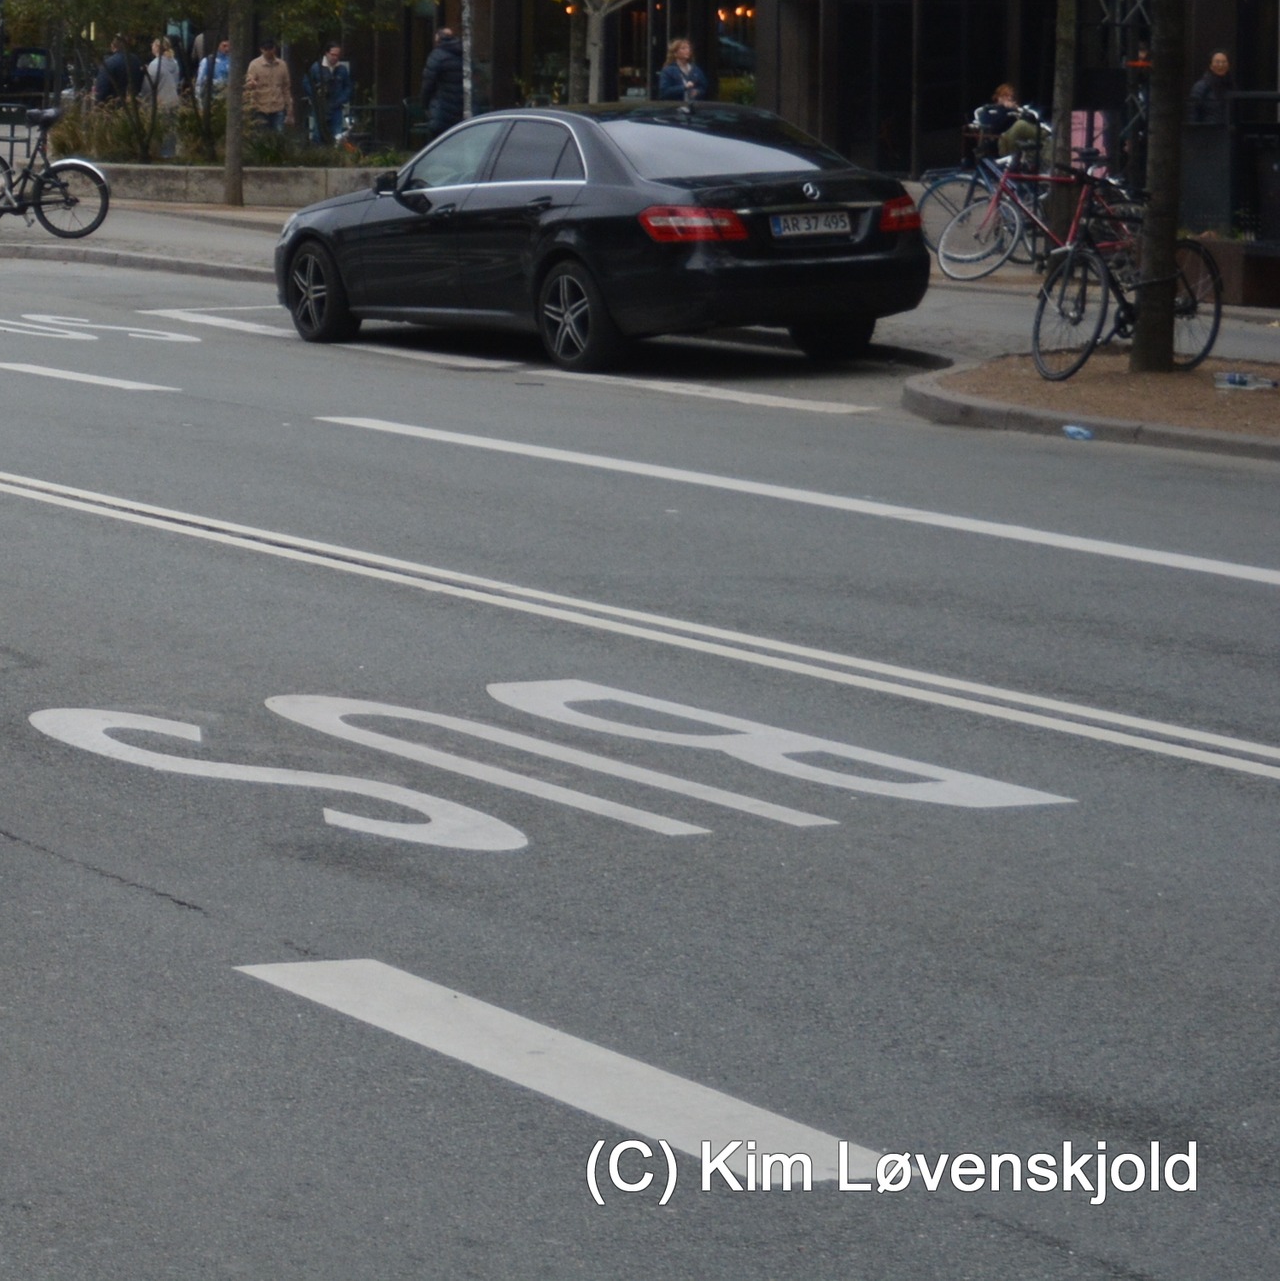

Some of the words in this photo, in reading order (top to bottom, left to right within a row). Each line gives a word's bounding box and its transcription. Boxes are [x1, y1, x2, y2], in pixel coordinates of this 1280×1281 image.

[783, 217, 801, 232] AR
[804, 216, 820, 231] 37
[823, 213, 848, 230] 495
[28, 679, 1079, 851] BUS
